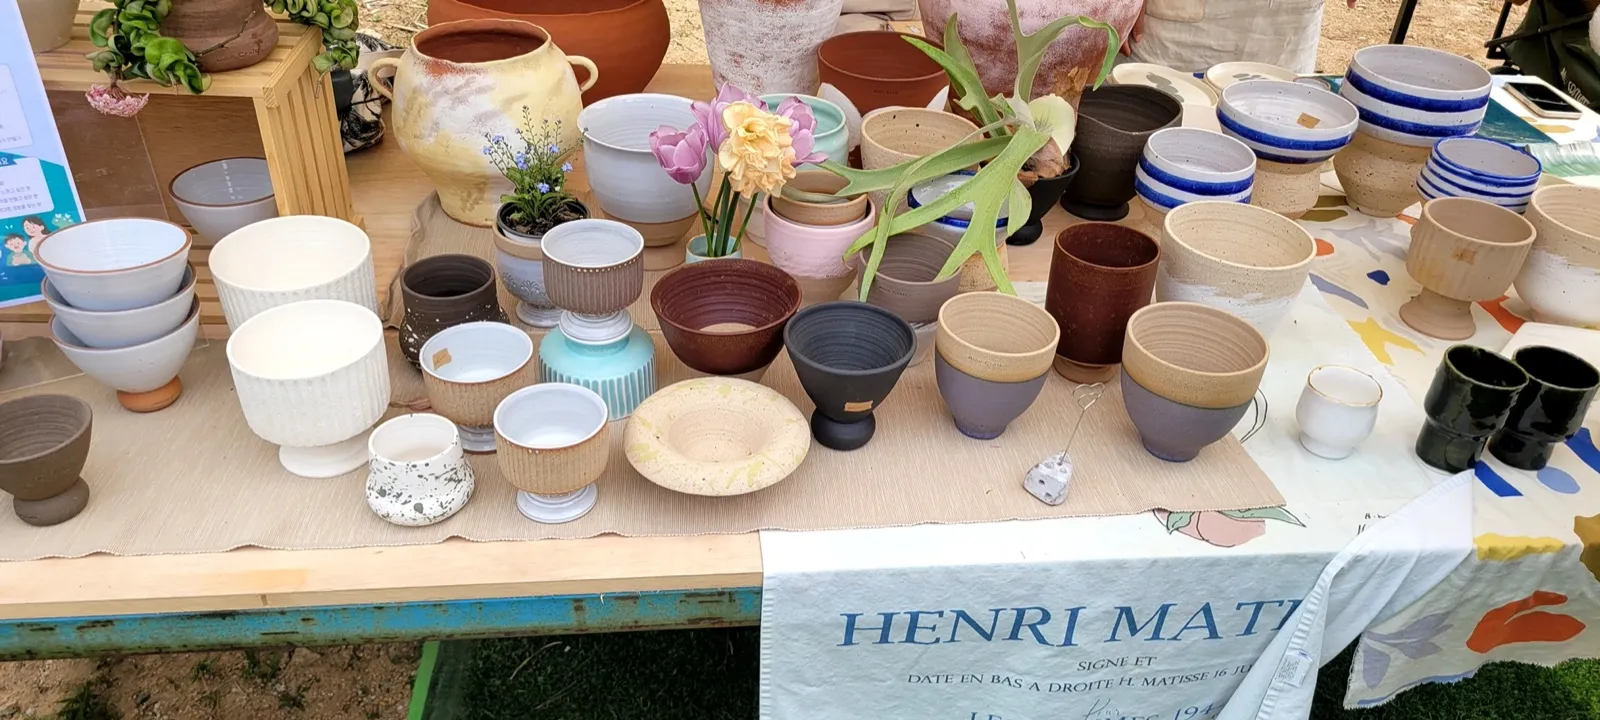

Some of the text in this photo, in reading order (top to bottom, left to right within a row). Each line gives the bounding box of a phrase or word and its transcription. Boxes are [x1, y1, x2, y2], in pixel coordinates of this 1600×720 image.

[836, 606, 1087, 647] HENRI
[1077, 655, 1157, 671] SIGNE ET
[907, 674, 954, 684] DATE
[960, 673, 984, 683] EN
[991, 674, 1023, 689] BAS
[1029, 681, 1041, 692] A
[1049, 678, 1115, 693] DROITE
[1118, 676, 1136, 687] H.
[1141, 671, 1210, 687] MATISSE
[1213, 667, 1228, 679] 16
